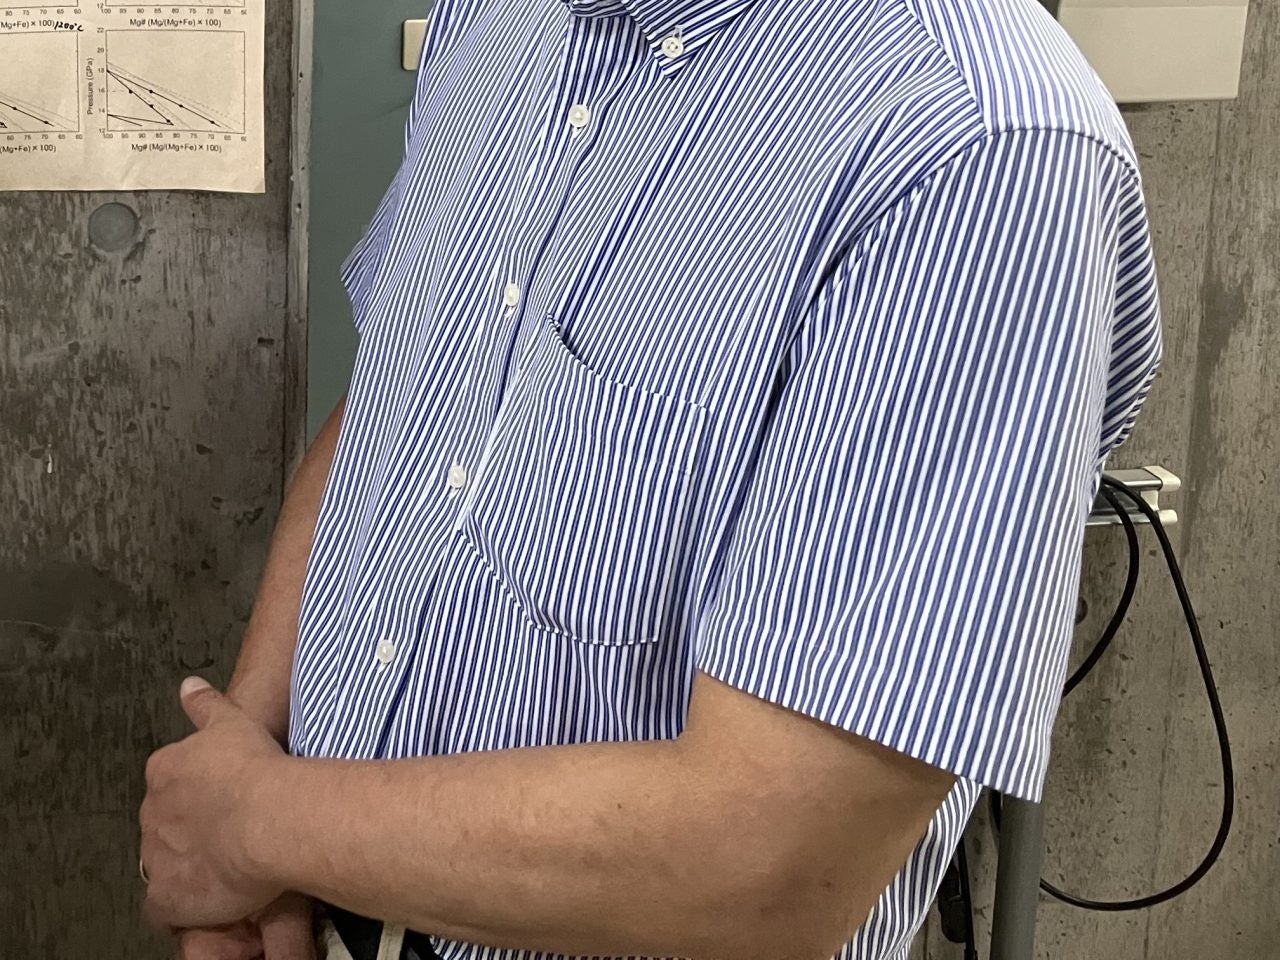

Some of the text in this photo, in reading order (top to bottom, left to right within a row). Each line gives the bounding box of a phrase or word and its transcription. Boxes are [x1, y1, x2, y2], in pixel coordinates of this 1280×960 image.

[38, 19, 55, 28] 100)
[205, 18, 222, 27] 100)
[40, 144, 56, 152] 100)
[206, 144, 222, 153] 100)
